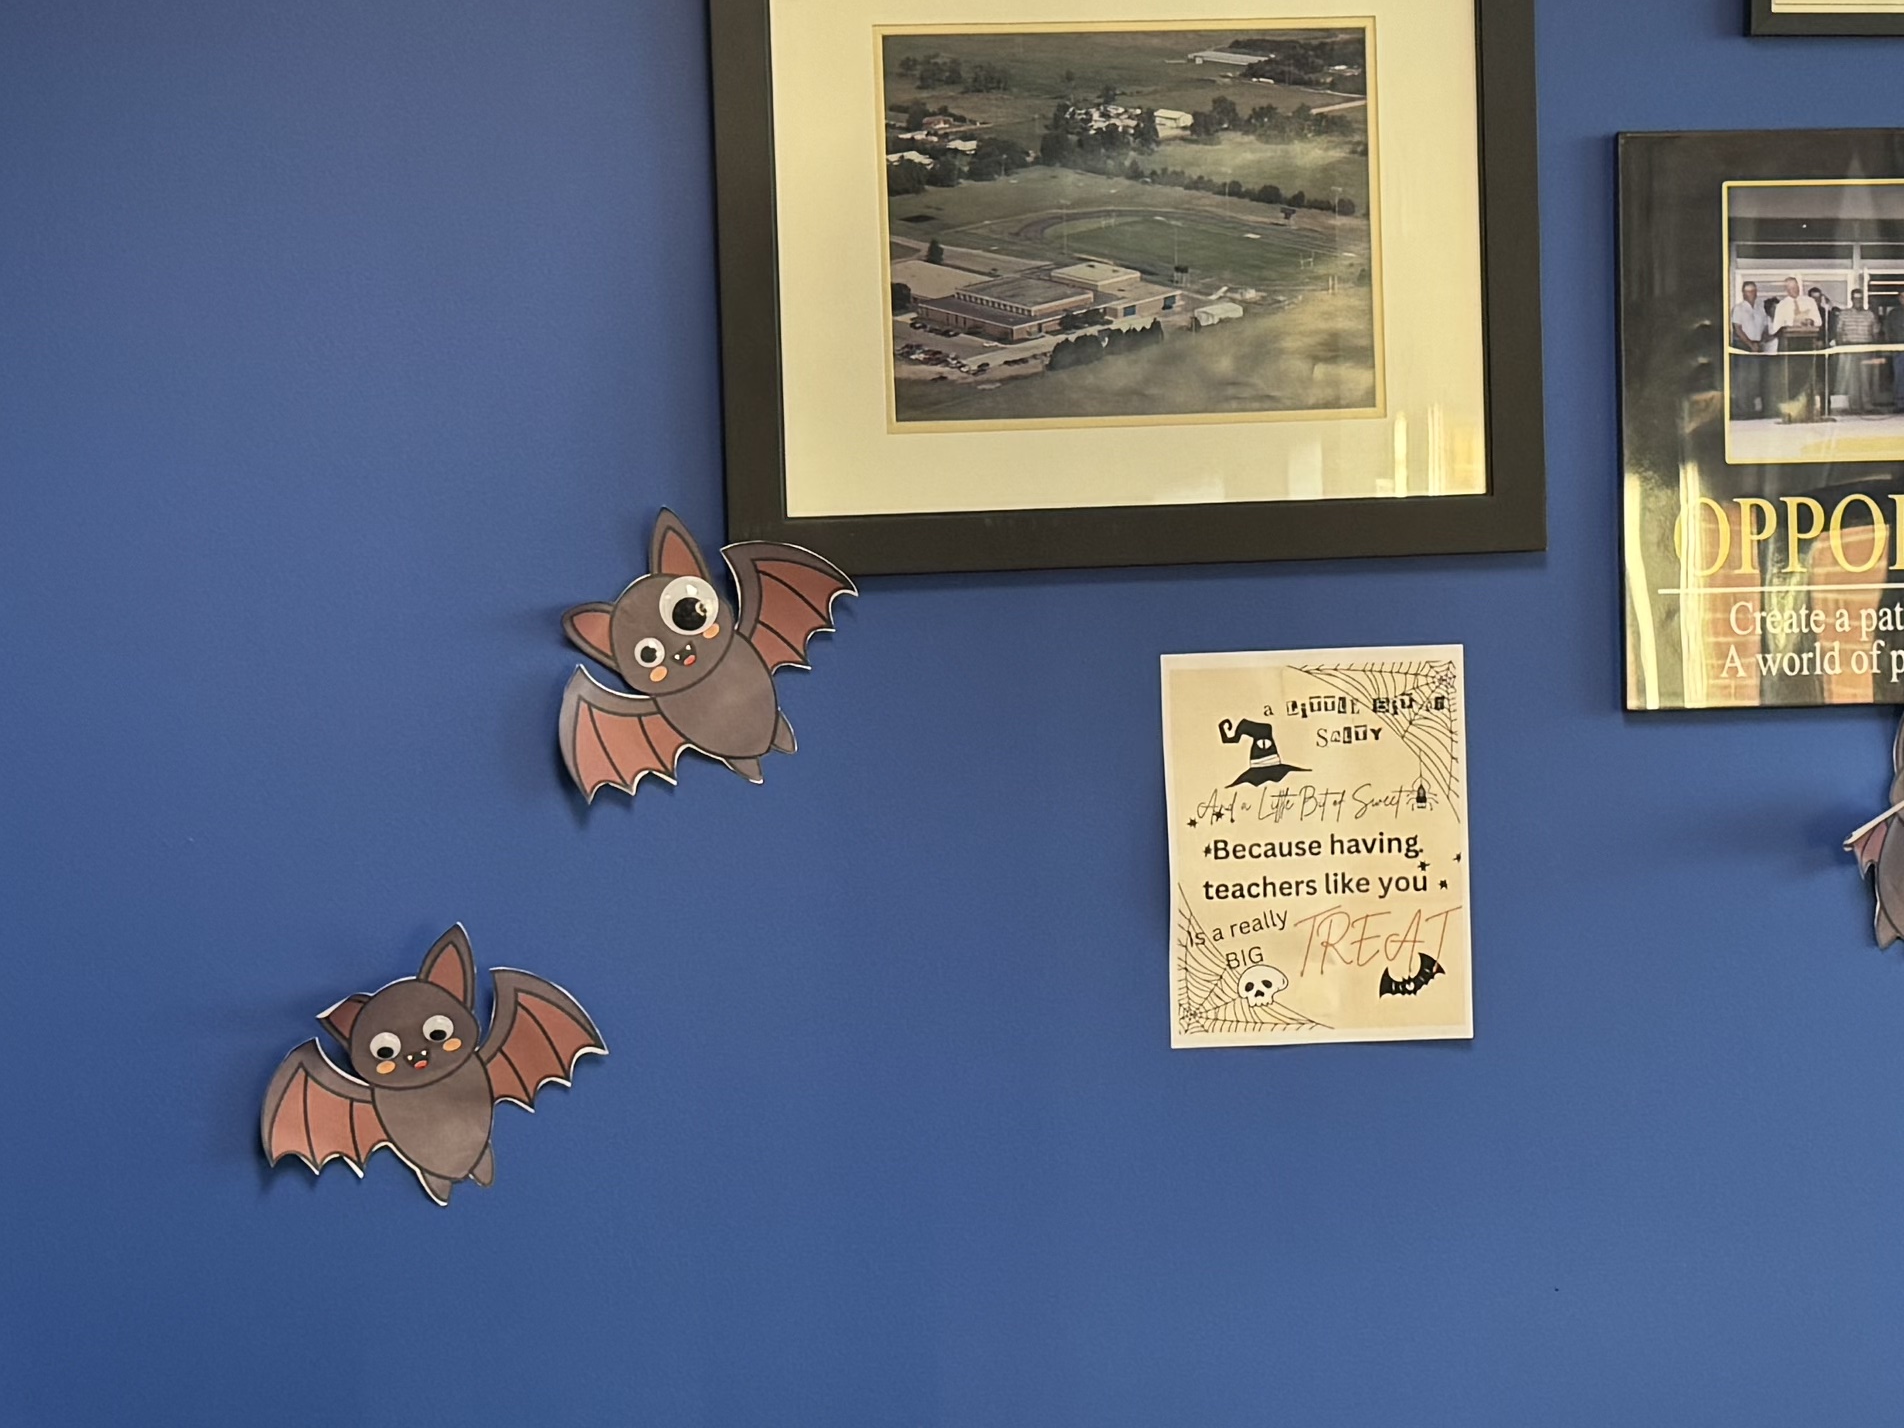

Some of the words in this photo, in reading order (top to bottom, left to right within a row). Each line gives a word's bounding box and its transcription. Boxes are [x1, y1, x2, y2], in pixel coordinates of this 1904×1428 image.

[1729, 600, 1825, 637] Create
[1835, 610, 1851, 632] a
[1720, 648, 1746, 677] A
[1755, 642, 1843, 675] world
[1851, 639, 1884, 672] of
[1263, 704, 1274, 717] a
[1197, 788, 1236, 824] And
[1241, 802, 1251, 811] a
[1257, 786, 1297, 823] Little
[1352, 783, 1413, 820] Sweet
[1212, 838, 1322, 860] Because
[1330, 832, 1420, 859] having
[1203, 876, 1318, 900] teachers
[1324, 873, 1370, 894] like
[1378, 875, 1428, 898] you
[1212, 927, 1224, 942] a
[1229, 909, 1288, 938] really
[1294, 905, 1462, 977] TREAT
[1225, 946, 1264, 969] BIG
